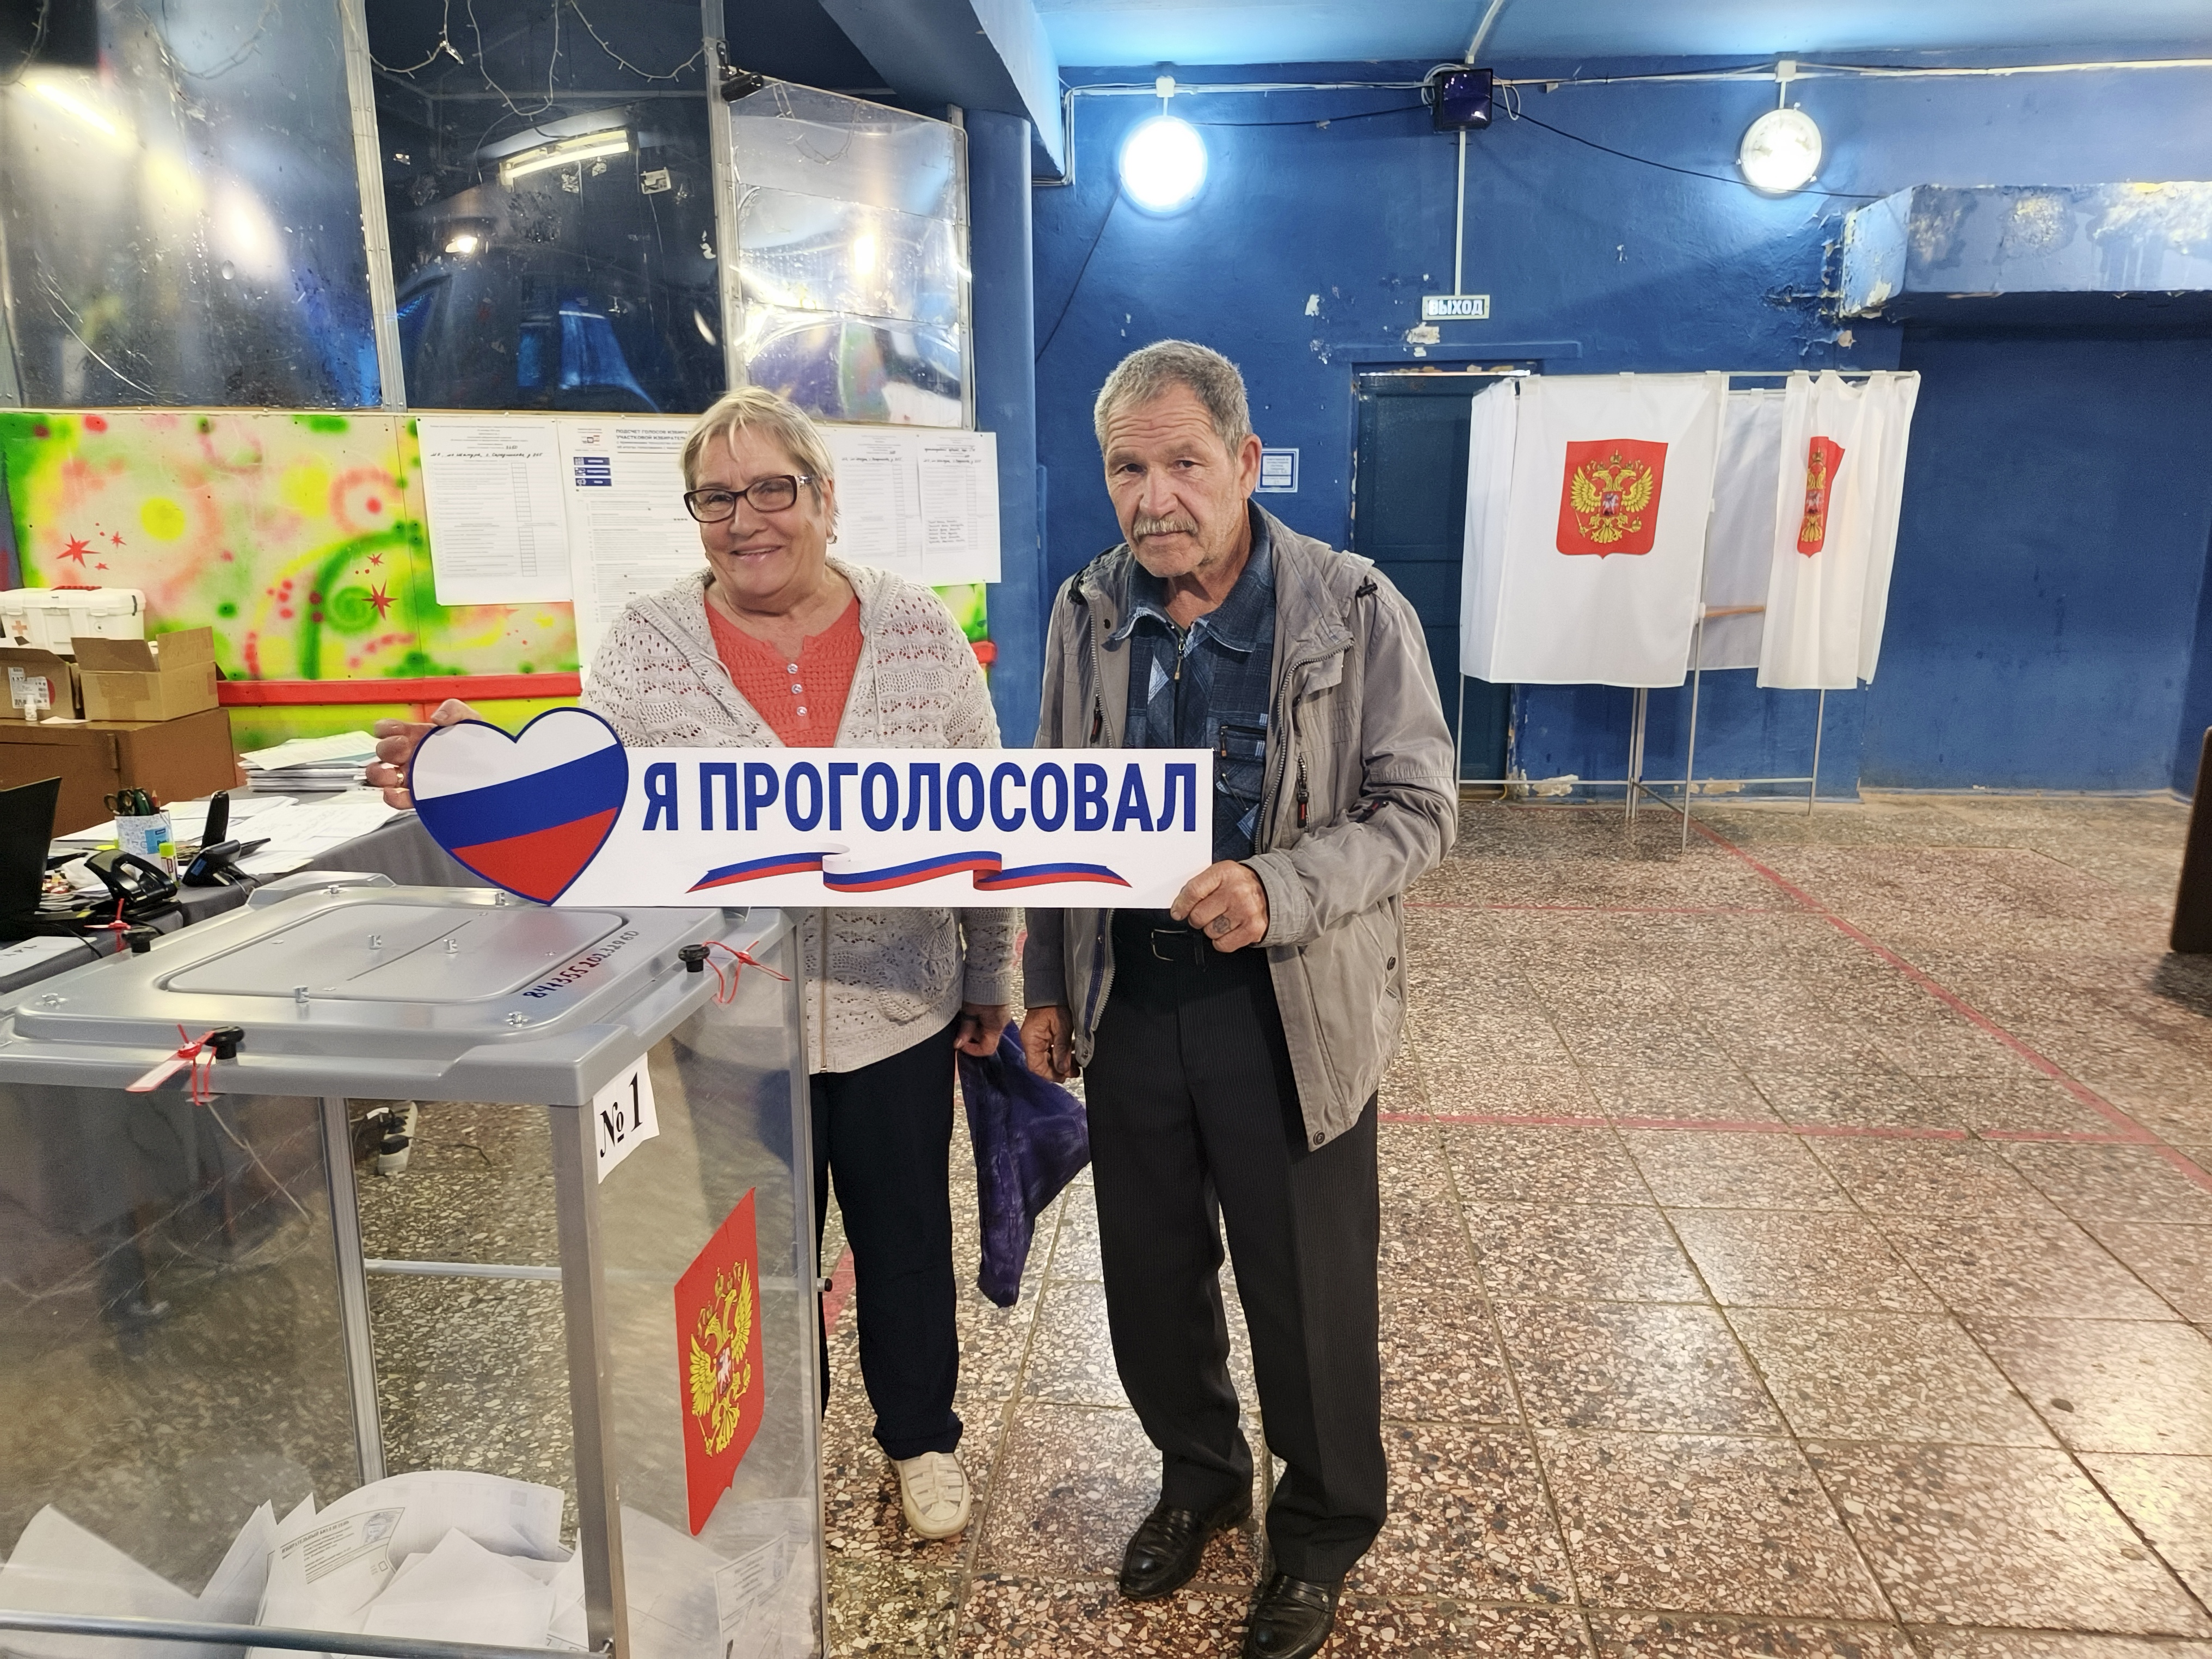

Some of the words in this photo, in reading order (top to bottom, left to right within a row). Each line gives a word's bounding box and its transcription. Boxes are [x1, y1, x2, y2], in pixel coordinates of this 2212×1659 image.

[1429, 299, 1483, 316] ВЫХОД
[643, 762, 678, 831] Я
[699, 761, 1196, 832] ПРОГОЛОСОВАЛ
[600, 1102, 624, 1158] №
[629, 1071, 643, 1133] 1
